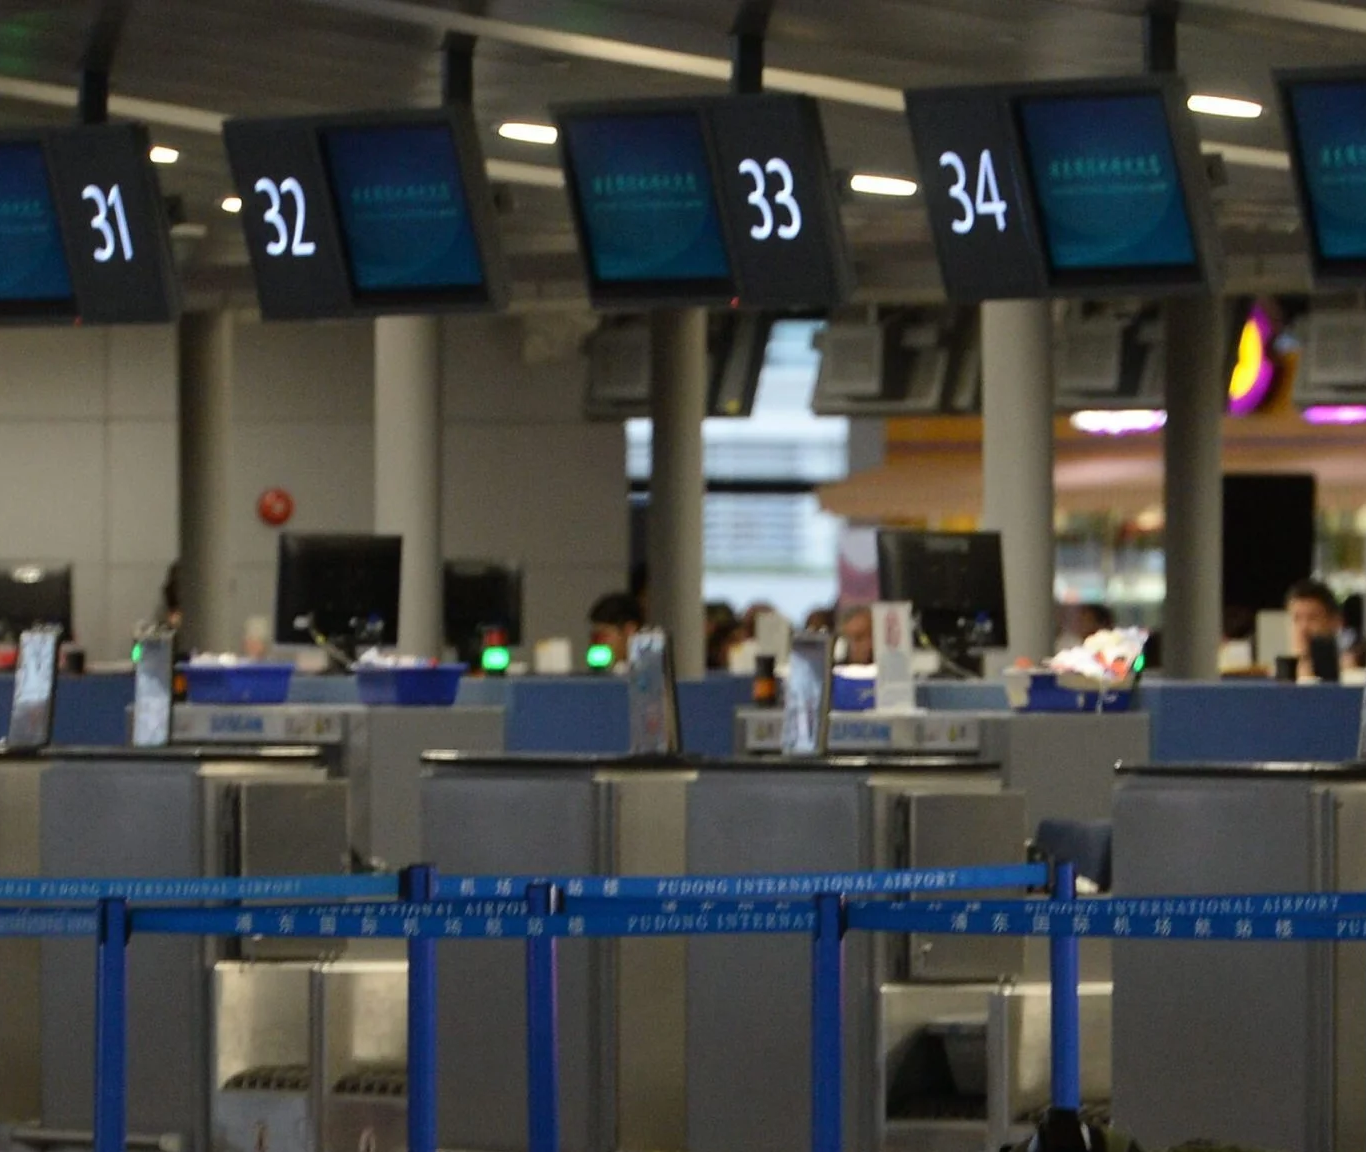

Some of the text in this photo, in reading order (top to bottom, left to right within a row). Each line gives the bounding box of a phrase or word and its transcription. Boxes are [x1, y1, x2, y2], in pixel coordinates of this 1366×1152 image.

[82, 184, 133, 262] 31
[254, 177, 316, 256] 32
[738, 157, 802, 240] 33
[939, 149, 1007, 234] 34
[657, 878, 729, 895] PUDONG
[735, 874, 876, 895] INTERNATIONAL
[883, 870, 959, 890] AIRPORT
[1262, 896, 1341, 914] AIRPORT
[627, 913, 709, 933] PUDONG
